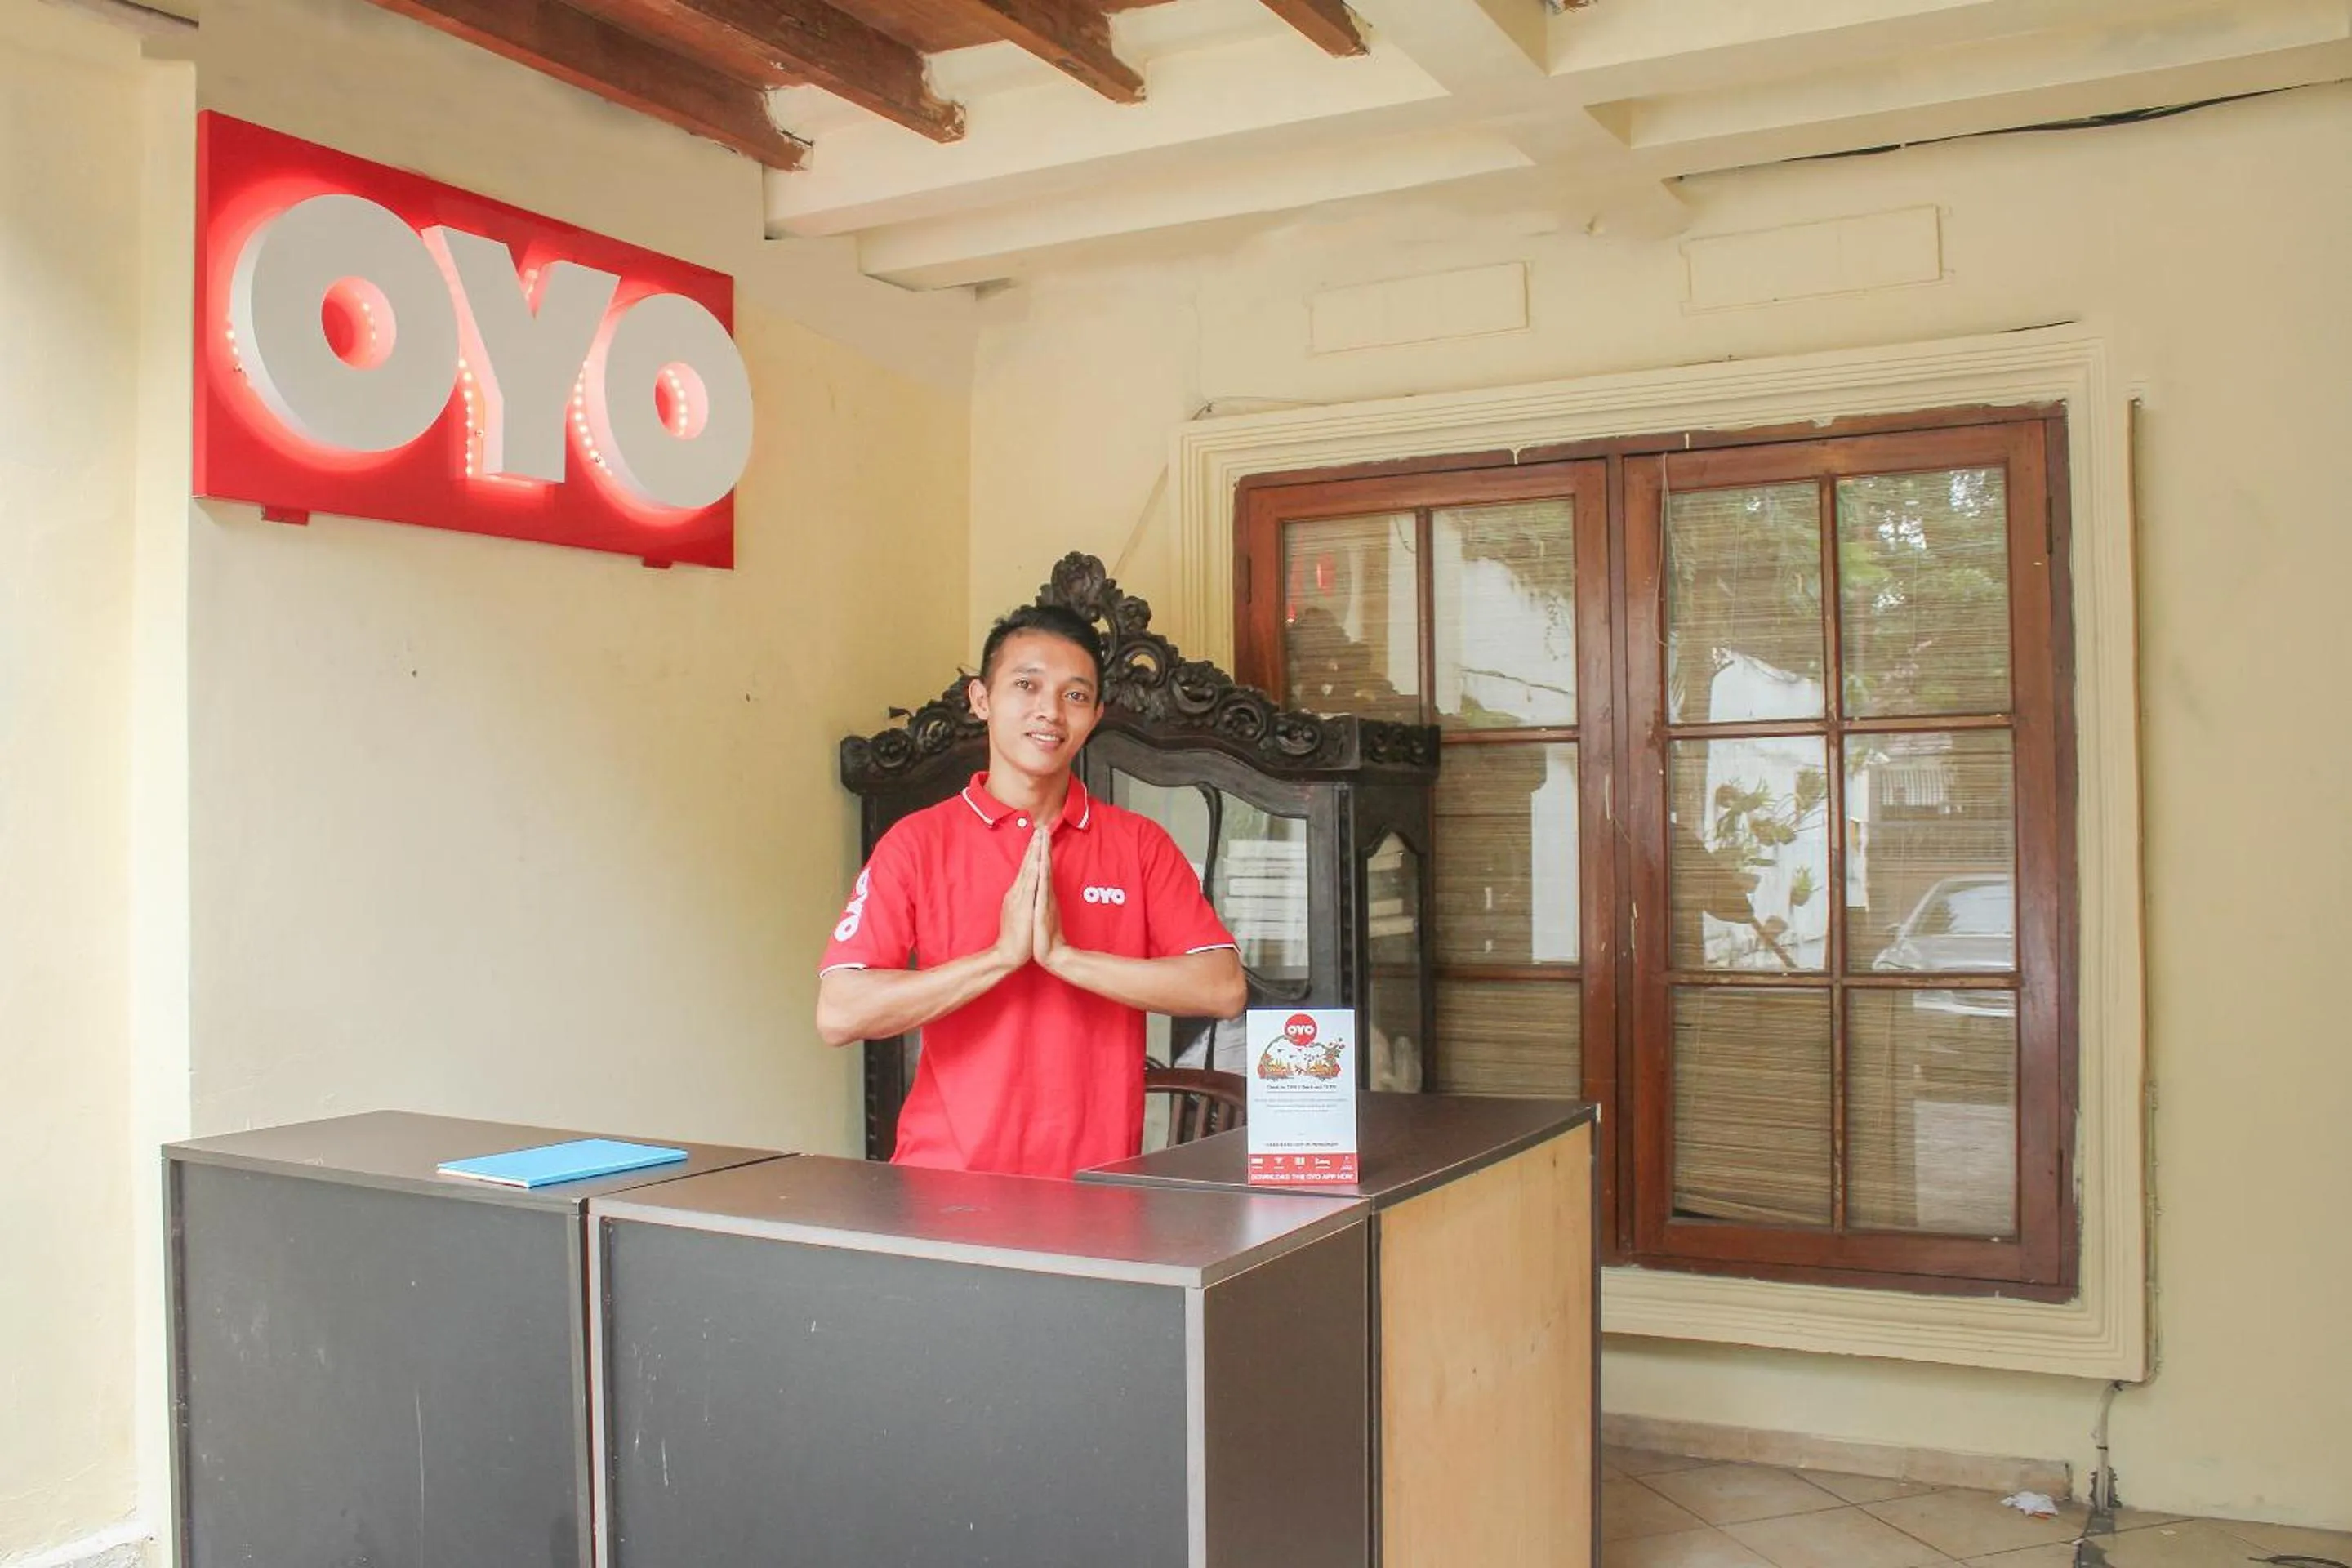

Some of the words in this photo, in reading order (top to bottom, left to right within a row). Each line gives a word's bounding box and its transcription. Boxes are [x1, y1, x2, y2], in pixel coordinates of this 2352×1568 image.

[232, 194, 753, 508] OYO
[1083, 887, 1125, 905] OYO
[1287, 1024, 1314, 1035] OYO
